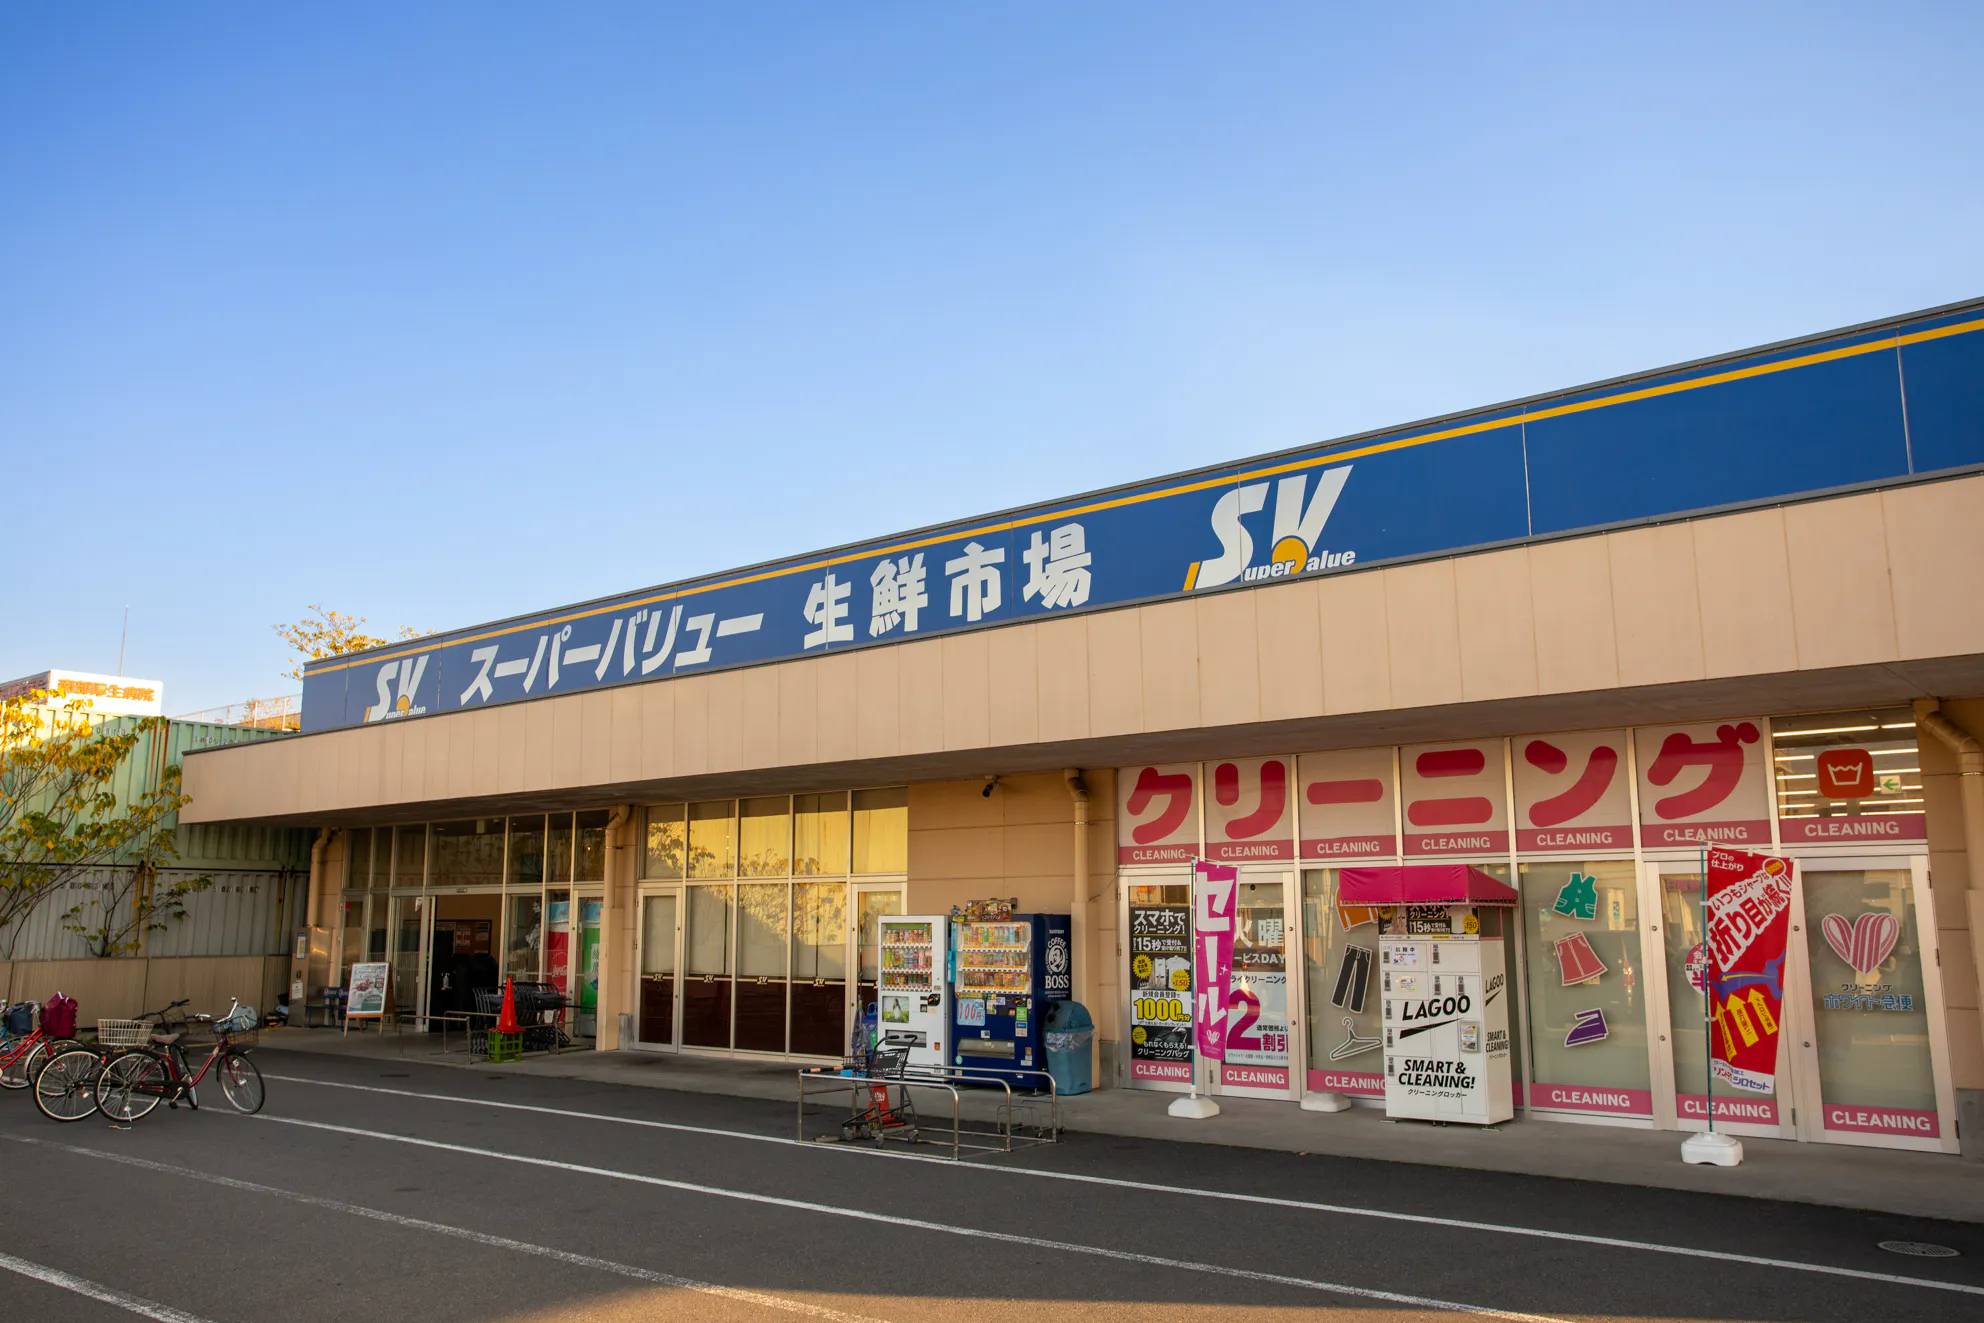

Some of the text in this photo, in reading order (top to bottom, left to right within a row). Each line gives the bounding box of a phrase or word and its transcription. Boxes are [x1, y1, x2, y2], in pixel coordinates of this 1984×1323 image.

[460, 523, 1092, 705] スーパーバリュー 生鮮市場
[1127, 722, 1760, 845] クリーニング
[1663, 827, 1748, 841] CLEANING
[1805, 821, 1899, 836] CLEANING
[1422, 836, 1491, 850] CLEANING
[1536, 832, 1612, 846] CLEANING
[1133, 849, 1186, 860] CLEANING
[1221, 845, 1279, 857] CLEANING
[1317, 841, 1380, 854] CLEANING
[1711, 851, 1734, 861] プロの
[1711, 860, 1744, 871] 仕上がり
[1711, 871, 1770, 911] いつもシャープな
[1133, 909, 1186, 926] スマホで
[1410, 911, 1449, 919] クリーニング!
[1133, 925, 1186, 934] クリーニング!
[1047, 937, 1067, 948] COFFEE
[1137, 937, 1162, 951] 15秒
[1196, 871, 1235, 1027] セール
[1233, 953, 1286, 964] ービスDAY
[1045, 974, 1069, 989] BOSS
[1485, 973, 1504, 994] LAGOO
[1841, 983, 1893, 992] クリーニング
[1142, 991, 1180, 999] 新規会員登録で
[1823, 993, 1914, 1011] ホワイト急便
[1133, 998, 1191, 1022] 1000円分
[1402, 995, 1471, 1021] LAGOO
[1487, 1031, 1502, 1042] SMART
[1137, 1048, 1190, 1058] クリーニングバッグ
[1135, 1064, 1190, 1078] CLEANING
[1404, 1059, 1466, 1075] SMART &
[1226, 1070, 1285, 1084] CLEANING
[1398, 1072, 1476, 1089] CLEANING!
[1408, 1089, 1468, 1098] クリーニングロッカー
[1551, 1090, 1630, 1107] CLEANING
[1684, 1100, 1771, 1118] CLEANING
[1831, 1110, 1931, 1131] CLEANING
